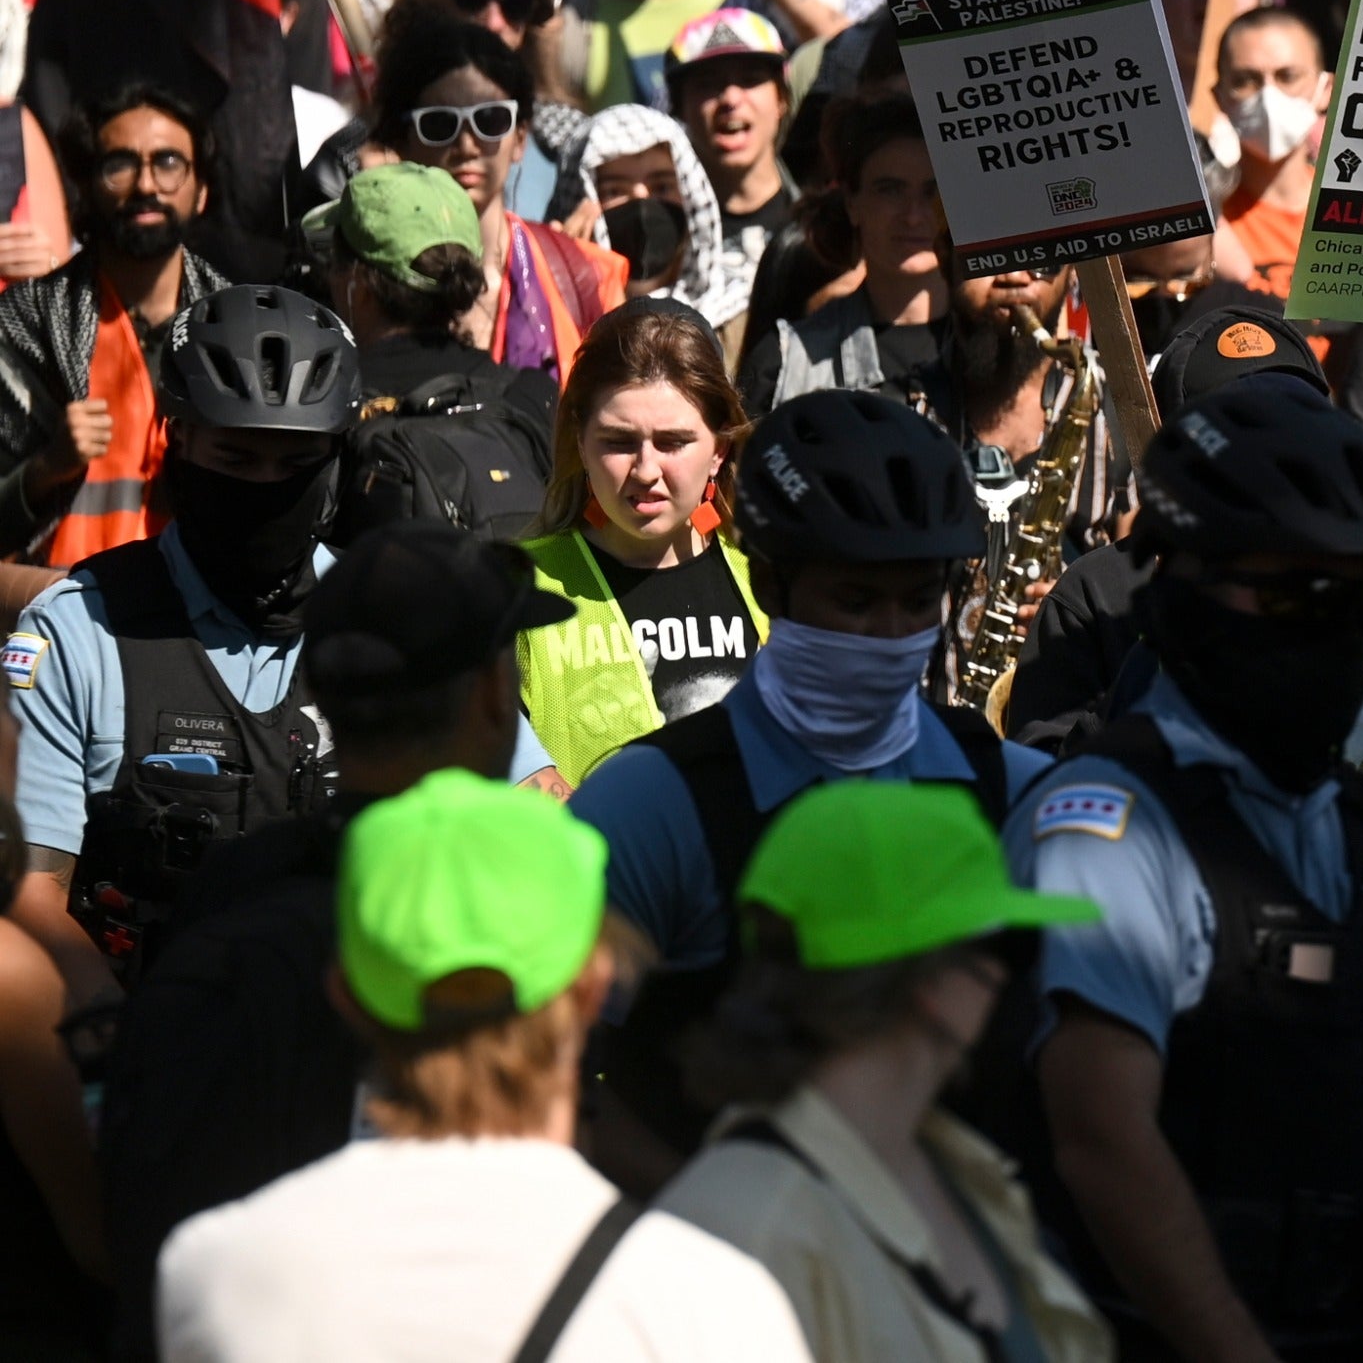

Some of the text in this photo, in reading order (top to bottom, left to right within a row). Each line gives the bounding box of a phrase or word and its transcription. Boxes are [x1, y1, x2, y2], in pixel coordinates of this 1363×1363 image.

[963, 35, 1099, 80] DEFEND
[936, 57, 1142, 114] LGBTQIA+ &
[938, 84, 1161, 143] REPRODUCTIVE
[976, 121, 1132, 173] RIGHTS!
[966, 215, 1206, 273] END AID TO ISRAEL!
[1310, 262, 1342, 274] and
[545, 615, 746, 674] MALCOLM
[174, 717, 225, 732] OLIVERA
[191, 739, 223, 748] DISTRICT
[195, 747, 227, 757] CENTRAL
